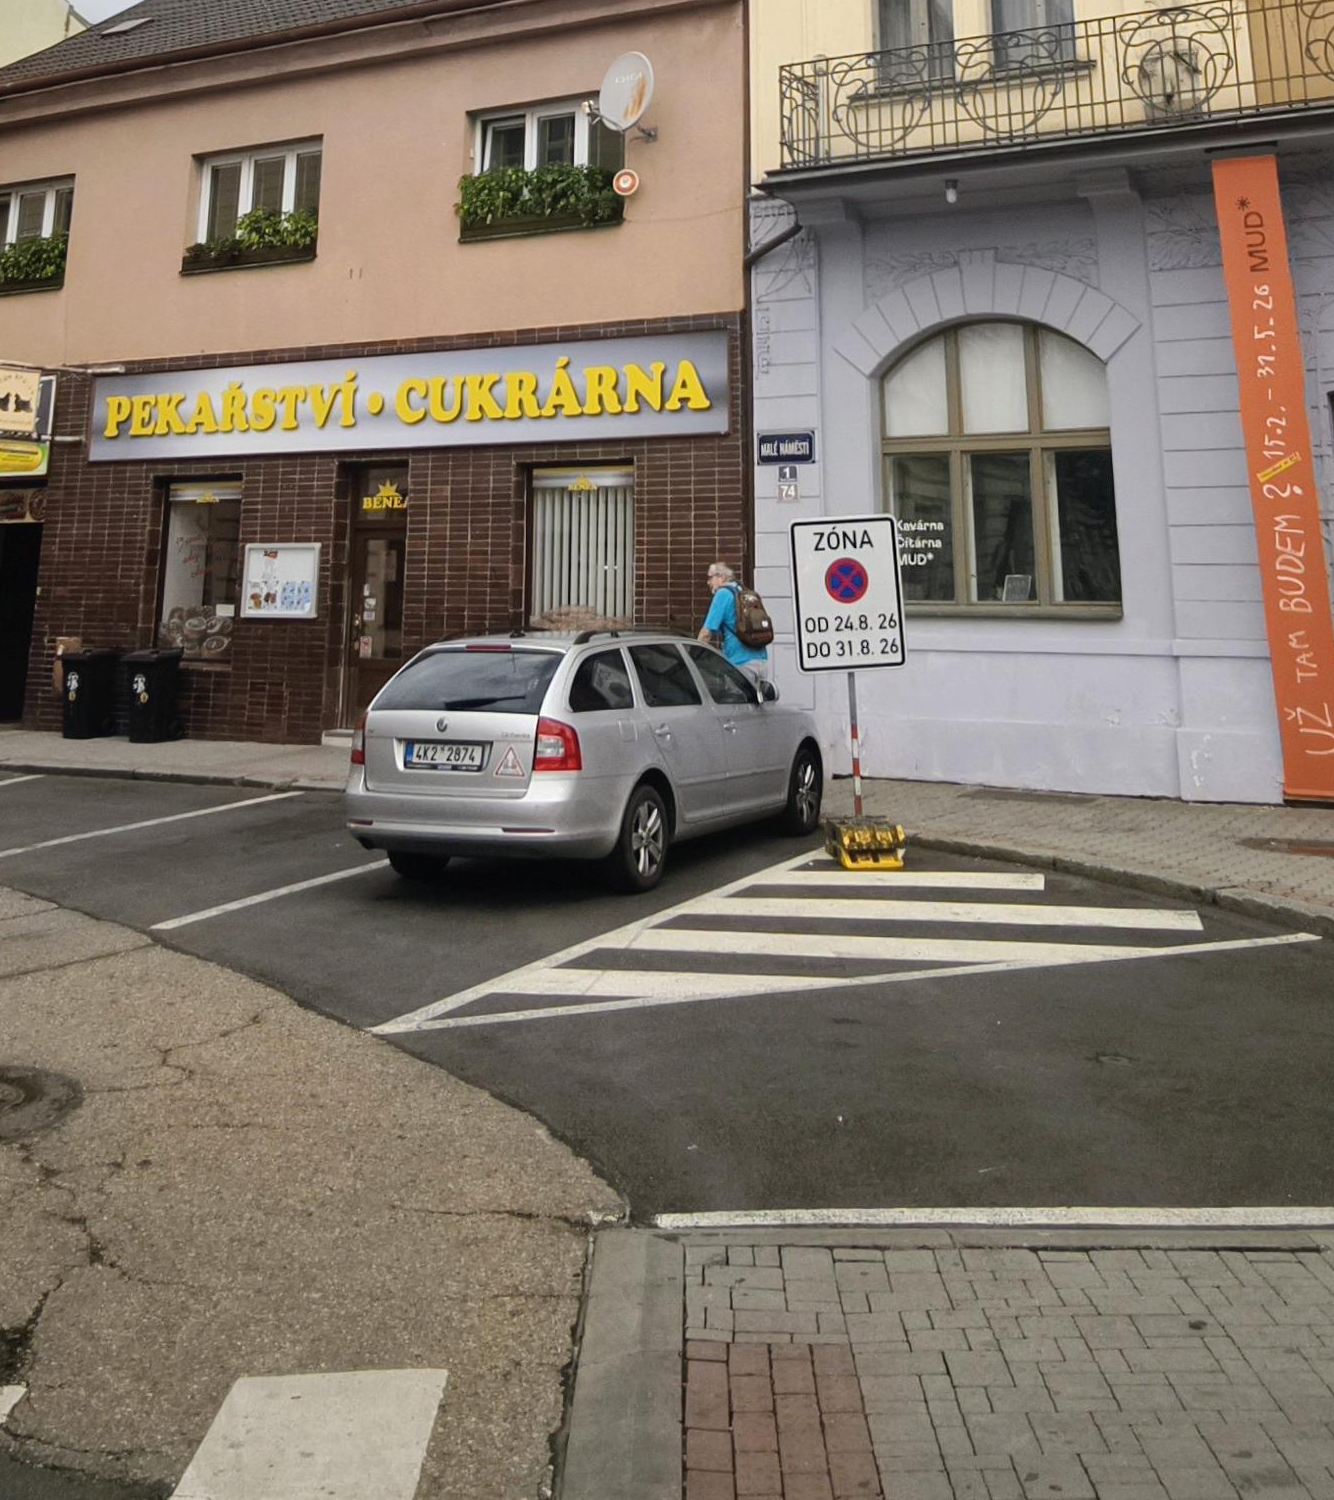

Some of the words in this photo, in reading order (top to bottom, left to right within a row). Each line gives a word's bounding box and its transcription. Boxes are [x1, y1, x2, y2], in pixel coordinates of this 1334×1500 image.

[104, 370, 357, 438] PEKAŘSTVÍ
[395, 356, 711, 424] CUKRÁRNA
[761, 440, 778, 457] MALÉ
[779, 439, 810, 456] NÁMĚSTÍ
[782, 466, 790, 479] 1
[779, 484, 796, 500] 74
[812, 525, 875, 552] ZÓNA
[1274, 513, 1313, 614] BUDEM
[804, 616, 830, 633] OD
[878, 612, 898, 630] 26
[807, 641, 831, 659] DO
[880, 637, 900, 655] 26
[1288, 630, 1317, 684] TAM
[415, 744, 437, 762] 4K2
